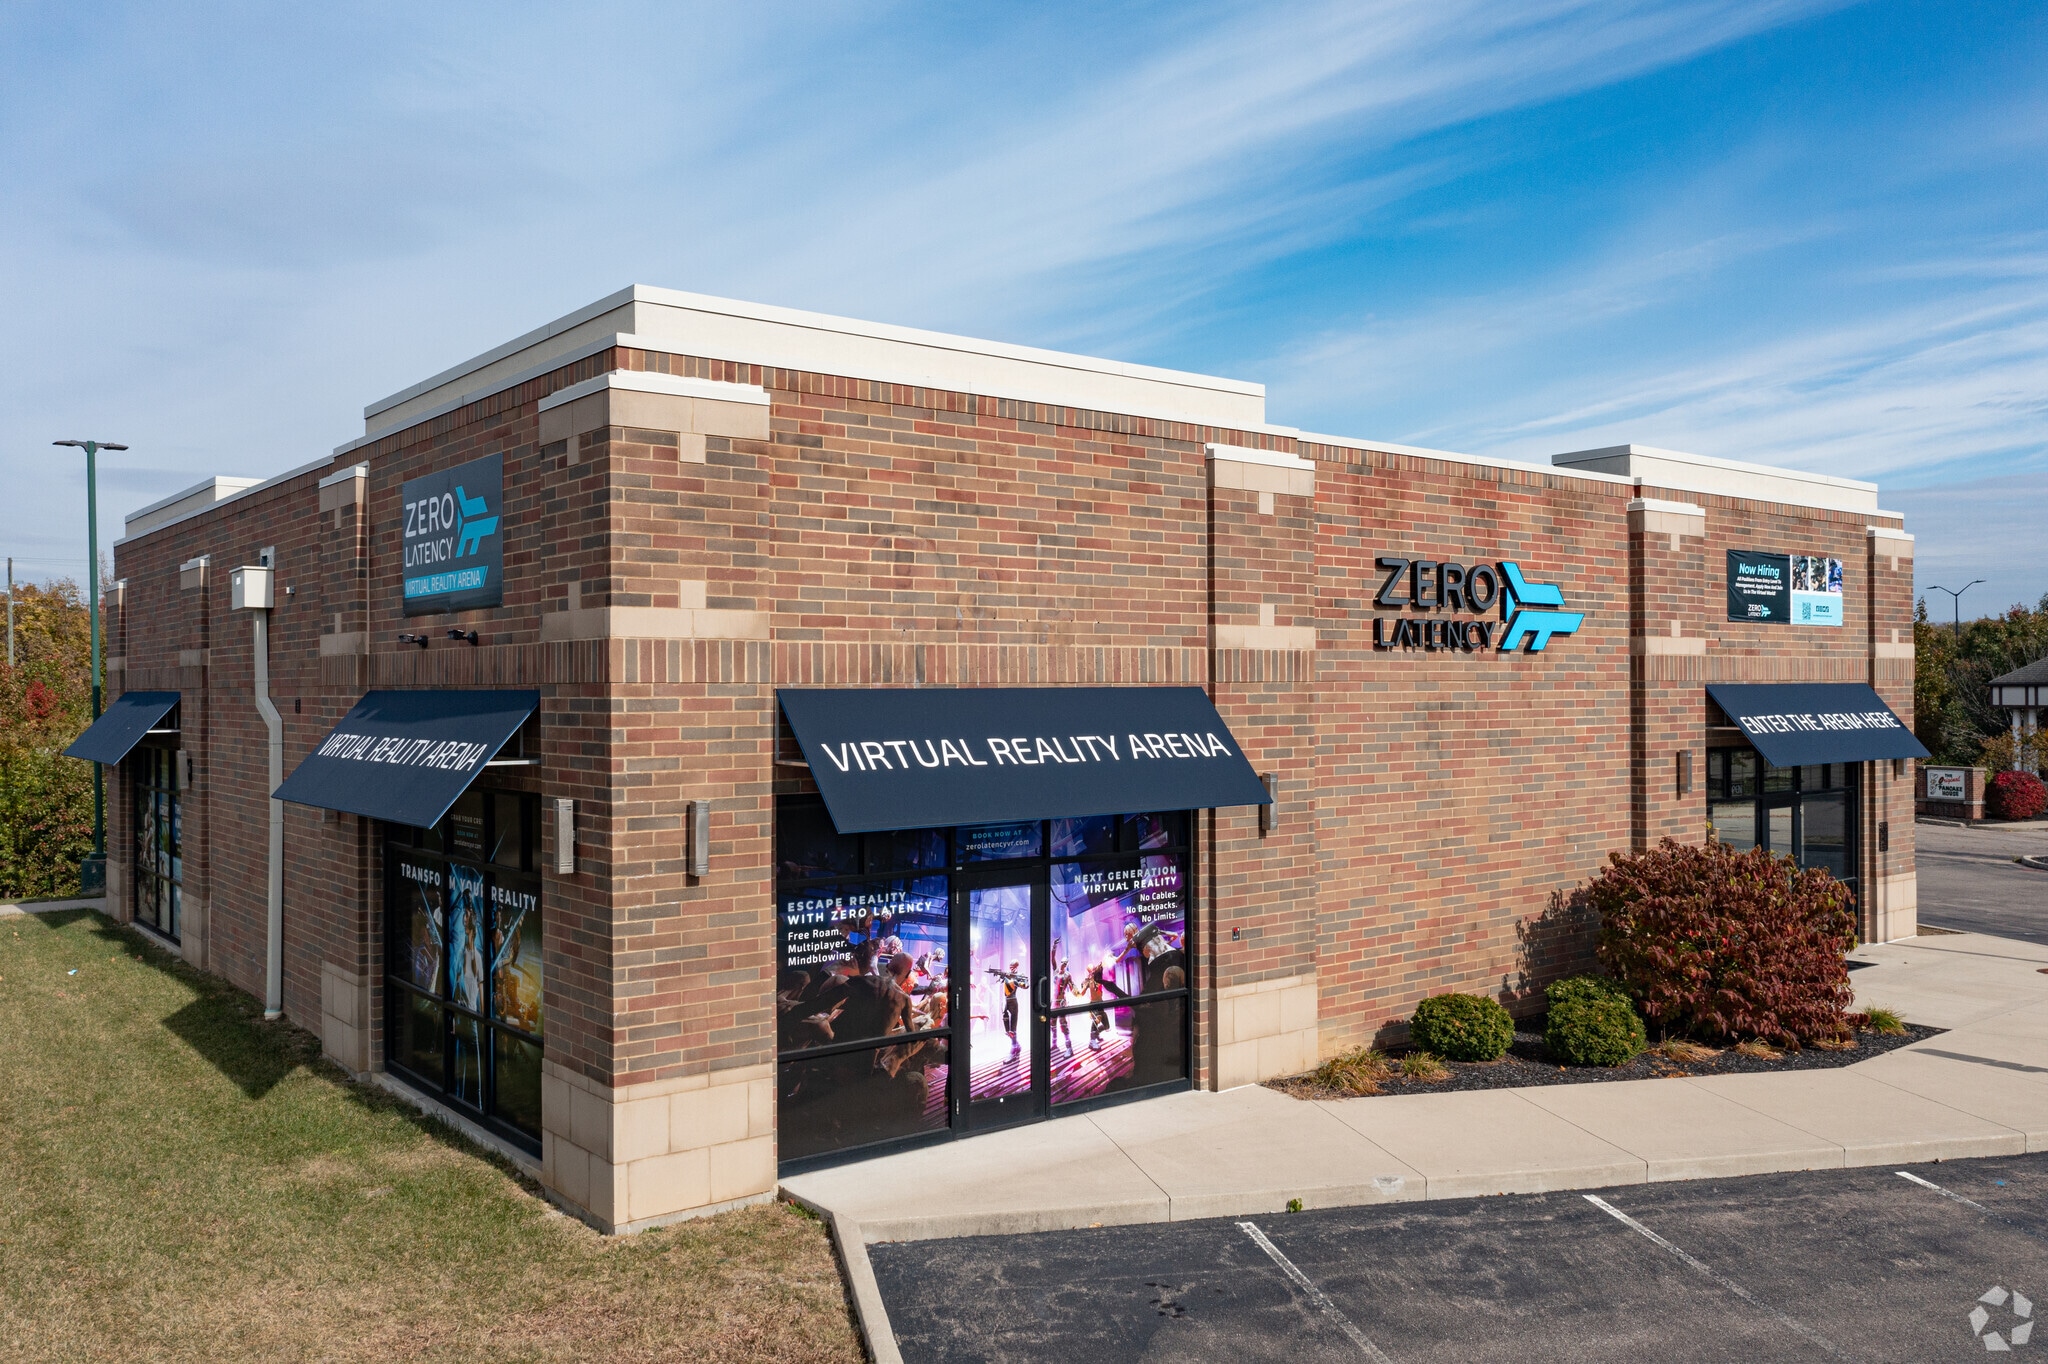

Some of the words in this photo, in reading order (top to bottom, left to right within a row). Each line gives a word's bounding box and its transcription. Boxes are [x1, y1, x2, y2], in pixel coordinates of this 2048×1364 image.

[405, 493, 454, 538] ZERO
[405, 537, 453, 567] LATENCY
[1739, 563, 1756, 574] Now
[1758, 564, 1780, 579] Hiring
[405, 576, 429, 597] VIRTUAL
[431, 572, 456, 592] REALITY
[458, 569, 481, 588] ARENA
[1375, 557, 1498, 610] ZERO
[1373, 617, 1496, 648] LATENCY
[1740, 714, 1795, 734] ENTER
[1786, 713, 1823, 730] THE
[1820, 712, 1867, 730] ARENA
[1864, 712, 1900, 728] HERE
[318, 733, 377, 760] VIRTUAL
[369, 737, 431, 766] REALITY
[427, 740, 488, 771] ARENA
[821, 738, 988, 772] VIRTUAL
[987, 735, 1121, 765] REALITY
[1129, 732, 1232, 759] ARENA
[1938, 776, 1960, 784] Original
[966, 839, 1030, 850] zerolatencyvr.com
[972, 831, 992, 839] BOOK
[1074, 873, 1103, 884] NEXT
[1108, 865, 1177, 881] GENERATION
[401, 863, 456, 890] TRANSFOM
[491, 886, 537, 911] REALITY
[1082, 880, 1129, 894] VIRTUAL
[1134, 876, 1177, 889] REALITY
[788, 898, 843, 912] ESCAPE
[849, 891, 907, 906] REALITY
[1140, 893, 1150, 901] No
[1152, 891, 1178, 900] Cables.
[788, 912, 824, 925] WITH
[831, 908, 867, 921] ZERO
[873, 901, 932, 917] LATENCY
[1126, 905, 1136, 914] No
[1138, 902, 1178, 914] Backpacks.
[1141, 914, 1152, 923] No
[1153, 912, 1178, 922] Limits.
[788, 931, 810, 941] Free
[812, 927, 842, 938] Roam.
[788, 940, 847, 954] Multiplayer.
[788, 951, 853, 967] Mindblowing.
